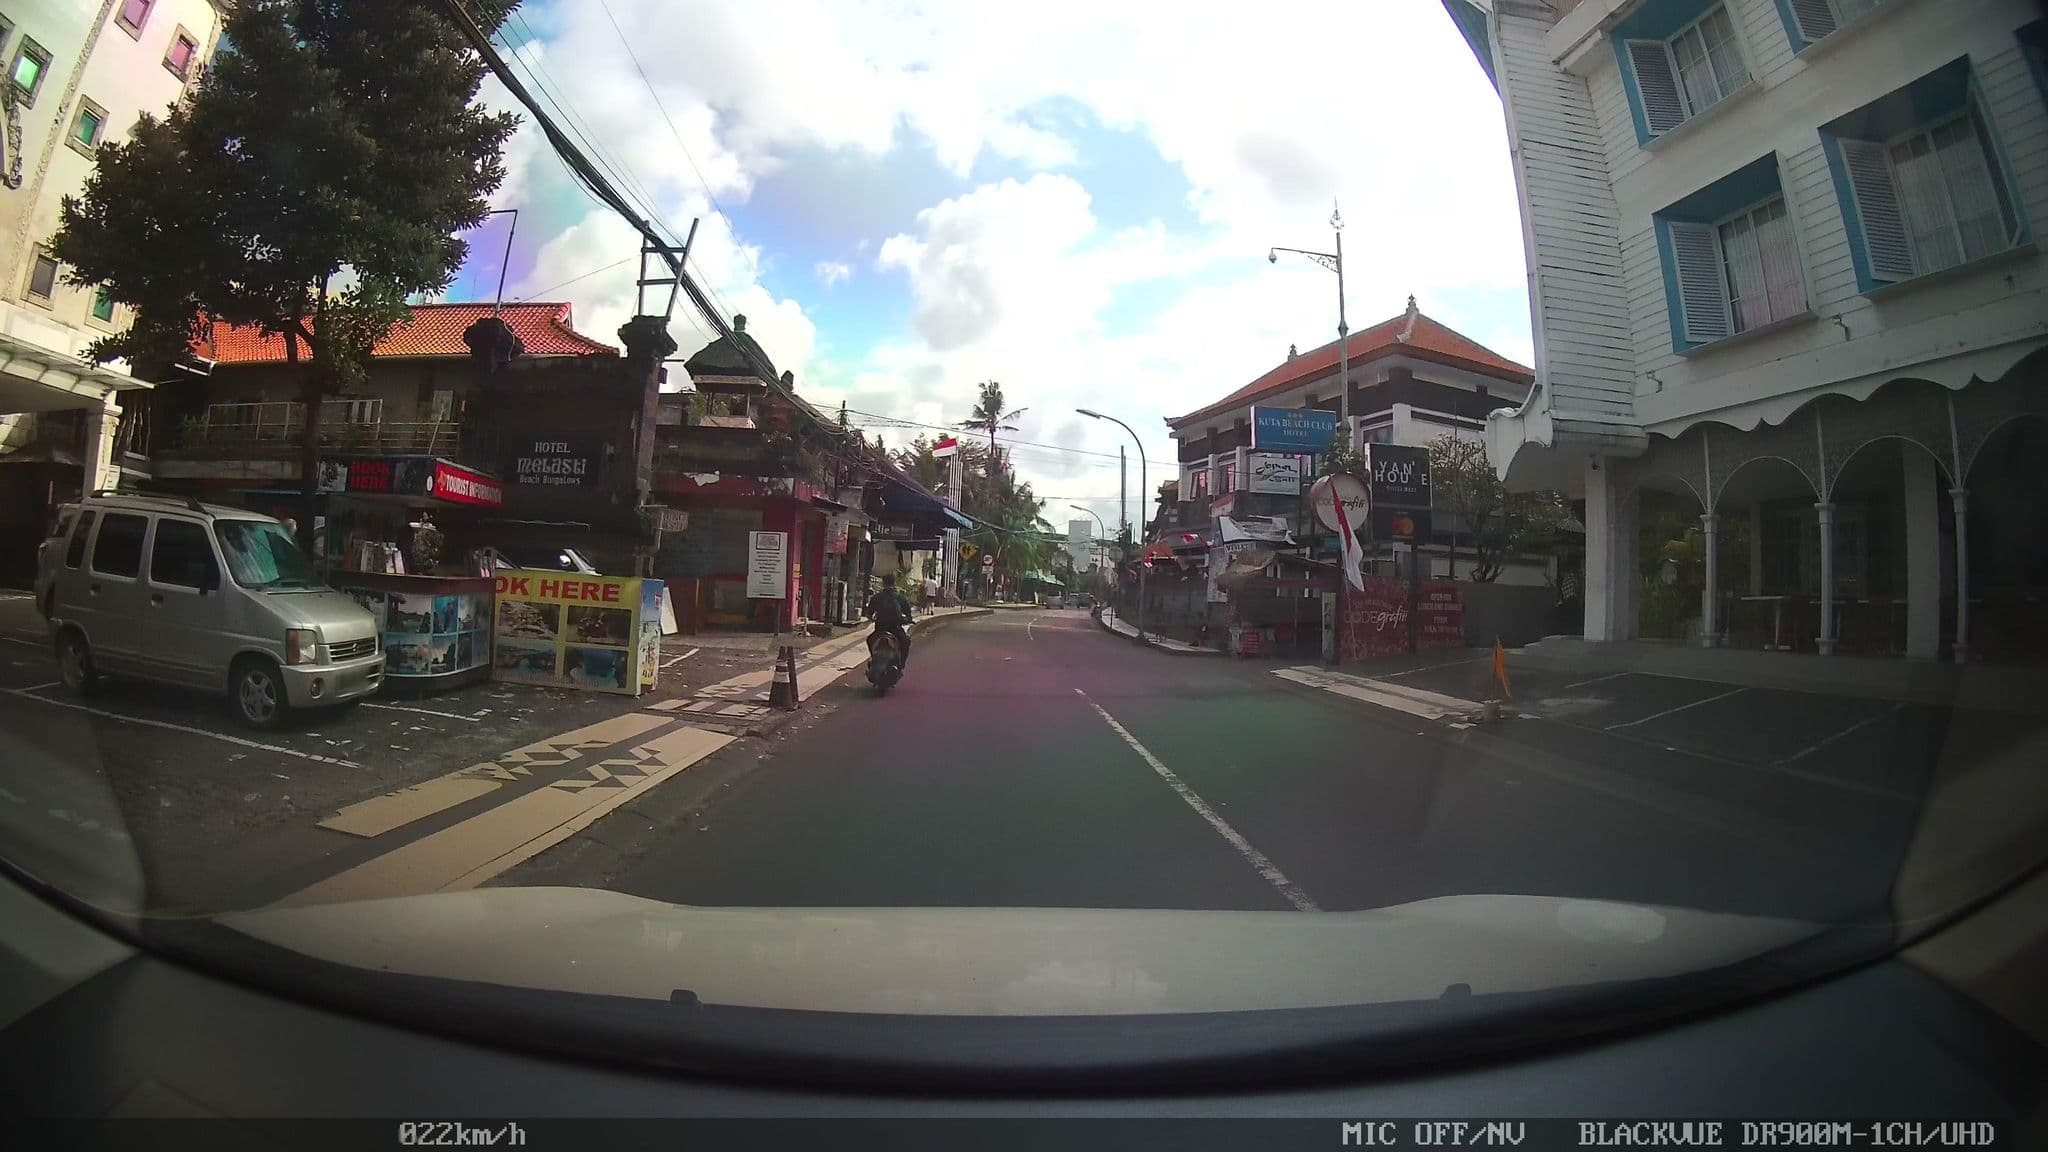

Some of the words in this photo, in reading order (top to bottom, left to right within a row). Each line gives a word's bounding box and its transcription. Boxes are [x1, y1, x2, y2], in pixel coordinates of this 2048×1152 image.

[1258, 417, 1281, 427] KUTA
[1282, 418, 1310, 429] BEACH
[1311, 420, 1333, 431] CLUB
[534, 441, 571, 453] HOTEL
[446, 474, 469, 496] TOURIST
[540, 579, 621, 602] HERE
